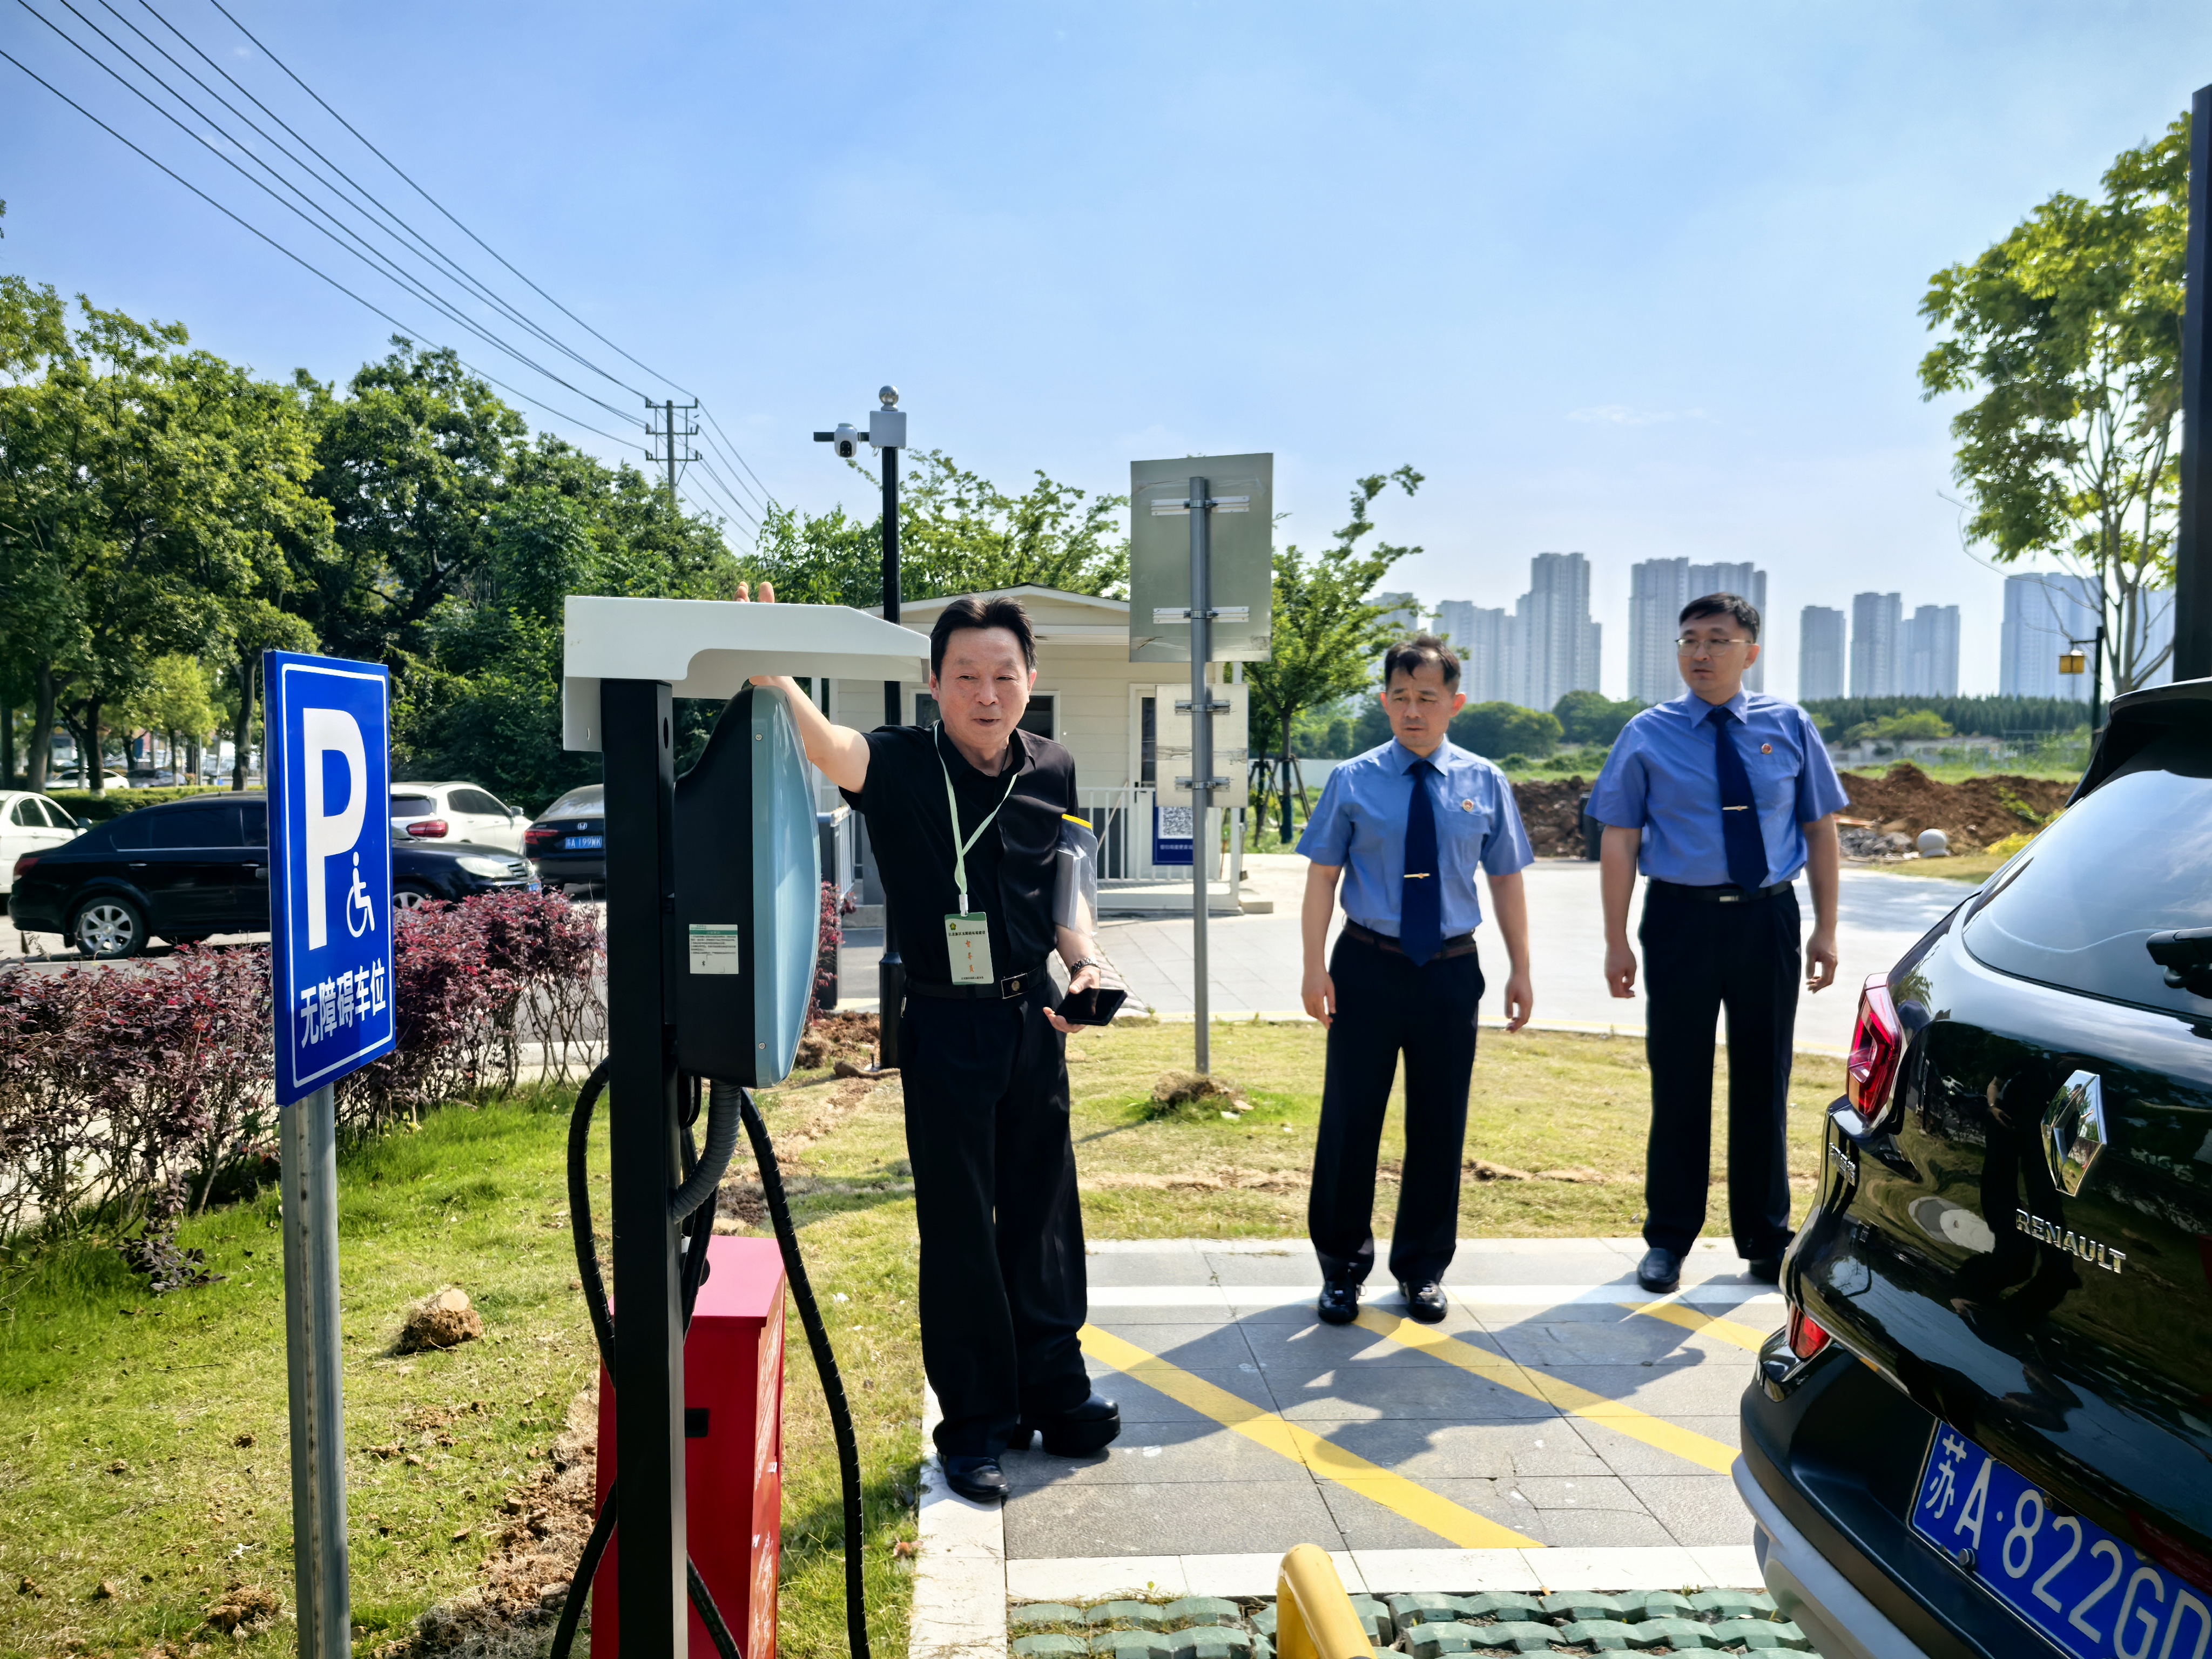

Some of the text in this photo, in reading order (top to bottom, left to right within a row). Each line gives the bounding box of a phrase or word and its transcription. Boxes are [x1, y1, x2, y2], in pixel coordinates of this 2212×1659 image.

[304, 707, 367, 950] P
[300, 957, 386, 1049] 无障碍车位
[2016, 1209, 2127, 1273] RENAULT
